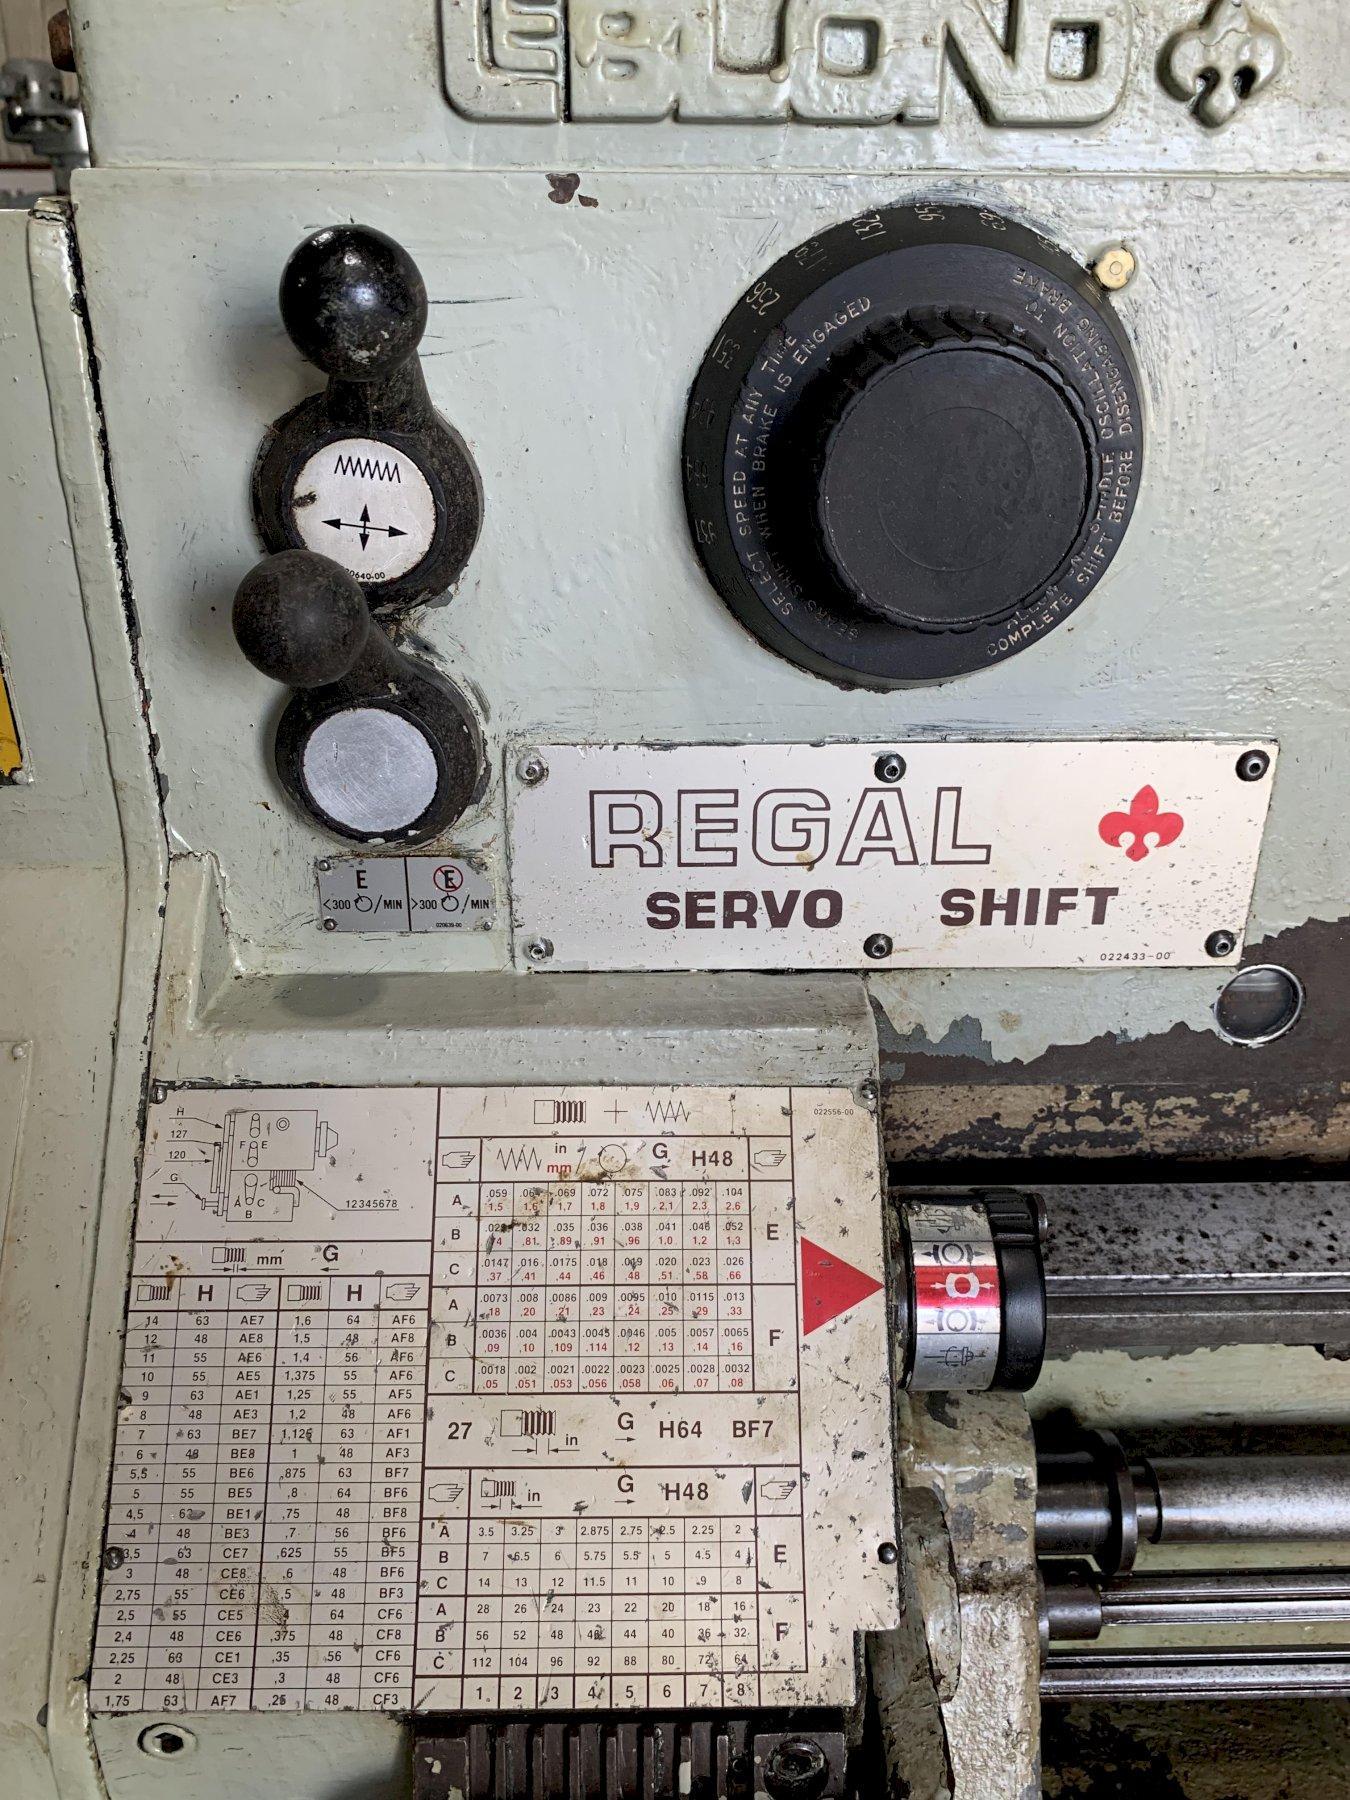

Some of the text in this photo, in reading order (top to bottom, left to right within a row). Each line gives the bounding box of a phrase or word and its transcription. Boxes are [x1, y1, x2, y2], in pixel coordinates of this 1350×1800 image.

[853, 214, 885, 240] 132
[1013, 267, 1072, 314] BRAKE
[746, 281, 780, 315] 256
[1024, 298, 1048, 324] TO
[792, 296, 872, 365] ENGAGED
[1052, 322, 1114, 440] OSCILLATION
[1076, 317, 1133, 435] DISENGAGING
[775, 372, 793, 393] IS
[746, 387, 766, 425] ANY
[735, 433, 748, 460] AT
[753, 404, 778, 483] BRAKE
[1109, 450, 1134, 523] BEFORE
[732, 470, 753, 536] SPEED
[752, 484, 772, 540] WHEN
[1077, 534, 1113, 586] SHIFT
[747, 550, 794, 616] SELECT
[988, 591, 1074, 657] COMPLETE
[589, 786, 991, 868] REGAL
[356, 870, 368, 889] E
[647, 886, 1119, 930] SERVO SHIFT
[1100, 952, 1170, 961] 022433-00
[171, 1130, 187, 1138] 127
[240, 1141, 246, 1149] F
[262, 1141, 268, 1149] E
[169, 1151, 185, 1159] 120
[555, 1143, 733, 1166] in G H48
[547, 1162, 571, 1173] mm
[170, 1173, 178, 1181] G
[234, 1200, 241, 1208] A
[257, 1199, 265, 1207] C
[346, 1200, 397, 1208] 12345678
[452, 1195, 462, 1205] A
[246, 1210, 252, 1218] B
[452, 1224, 779, 1240] B E
[257, 1245, 338, 1265] mm G
[449, 1263, 459, 1275] C
[198, 1285, 362, 1301] H H
[448, 1299, 458, 1310] A
[196, 1315, 415, 1325] 63 AE7 64 AF6
[239, 1333, 263, 1343] AE8
[448, 1329, 781, 1346] B F
[142, 1372, 154, 1381] 10
[193, 1372, 205, 1381] 55
[237, 1371, 260, 1381] AE5
[445, 1370, 455, 1382] C
[143, 1389, 412, 1401] 9 AE1 AF5
[233, 1409, 257, 1419] AE3
[232, 1428, 409, 1439] BE7 AF1
[448, 1412, 773, 1445] 27 in G H64 BF7
[183, 1468, 196, 1478] 55
[528, 1474, 709, 1501] in G H48
[439, 1525, 449, 1537] A
[479, 1525, 740, 1536] 3.5 3.25 2.875 2.25 2
[439, 1545, 787, 1564] B E
[483, 1551, 606, 1561] 7 6 5.75
[437, 1576, 447, 1589] C
[479, 1576, 674, 1587] 14 13 11.5 10
[380, 1588, 403, 1598] BF3
[436, 1603, 446, 1615] A
[477, 1603, 600, 1614] 28 23
[218, 1609, 402, 1621] CE5 CF6
[377, 1629, 401, 1640] CF8
[435, 1622, 788, 1642] B F
[476, 1630, 526, 1640] 56 52
[433, 1656, 444, 1669] C
[473, 1655, 674, 1667] 112 80
[213, 1673, 238, 1684] CE3
[476, 1683, 745, 1700] 1 2 3 4 5 6 7 8
[164, 1694, 398, 1706] 63 AF7 CF3
